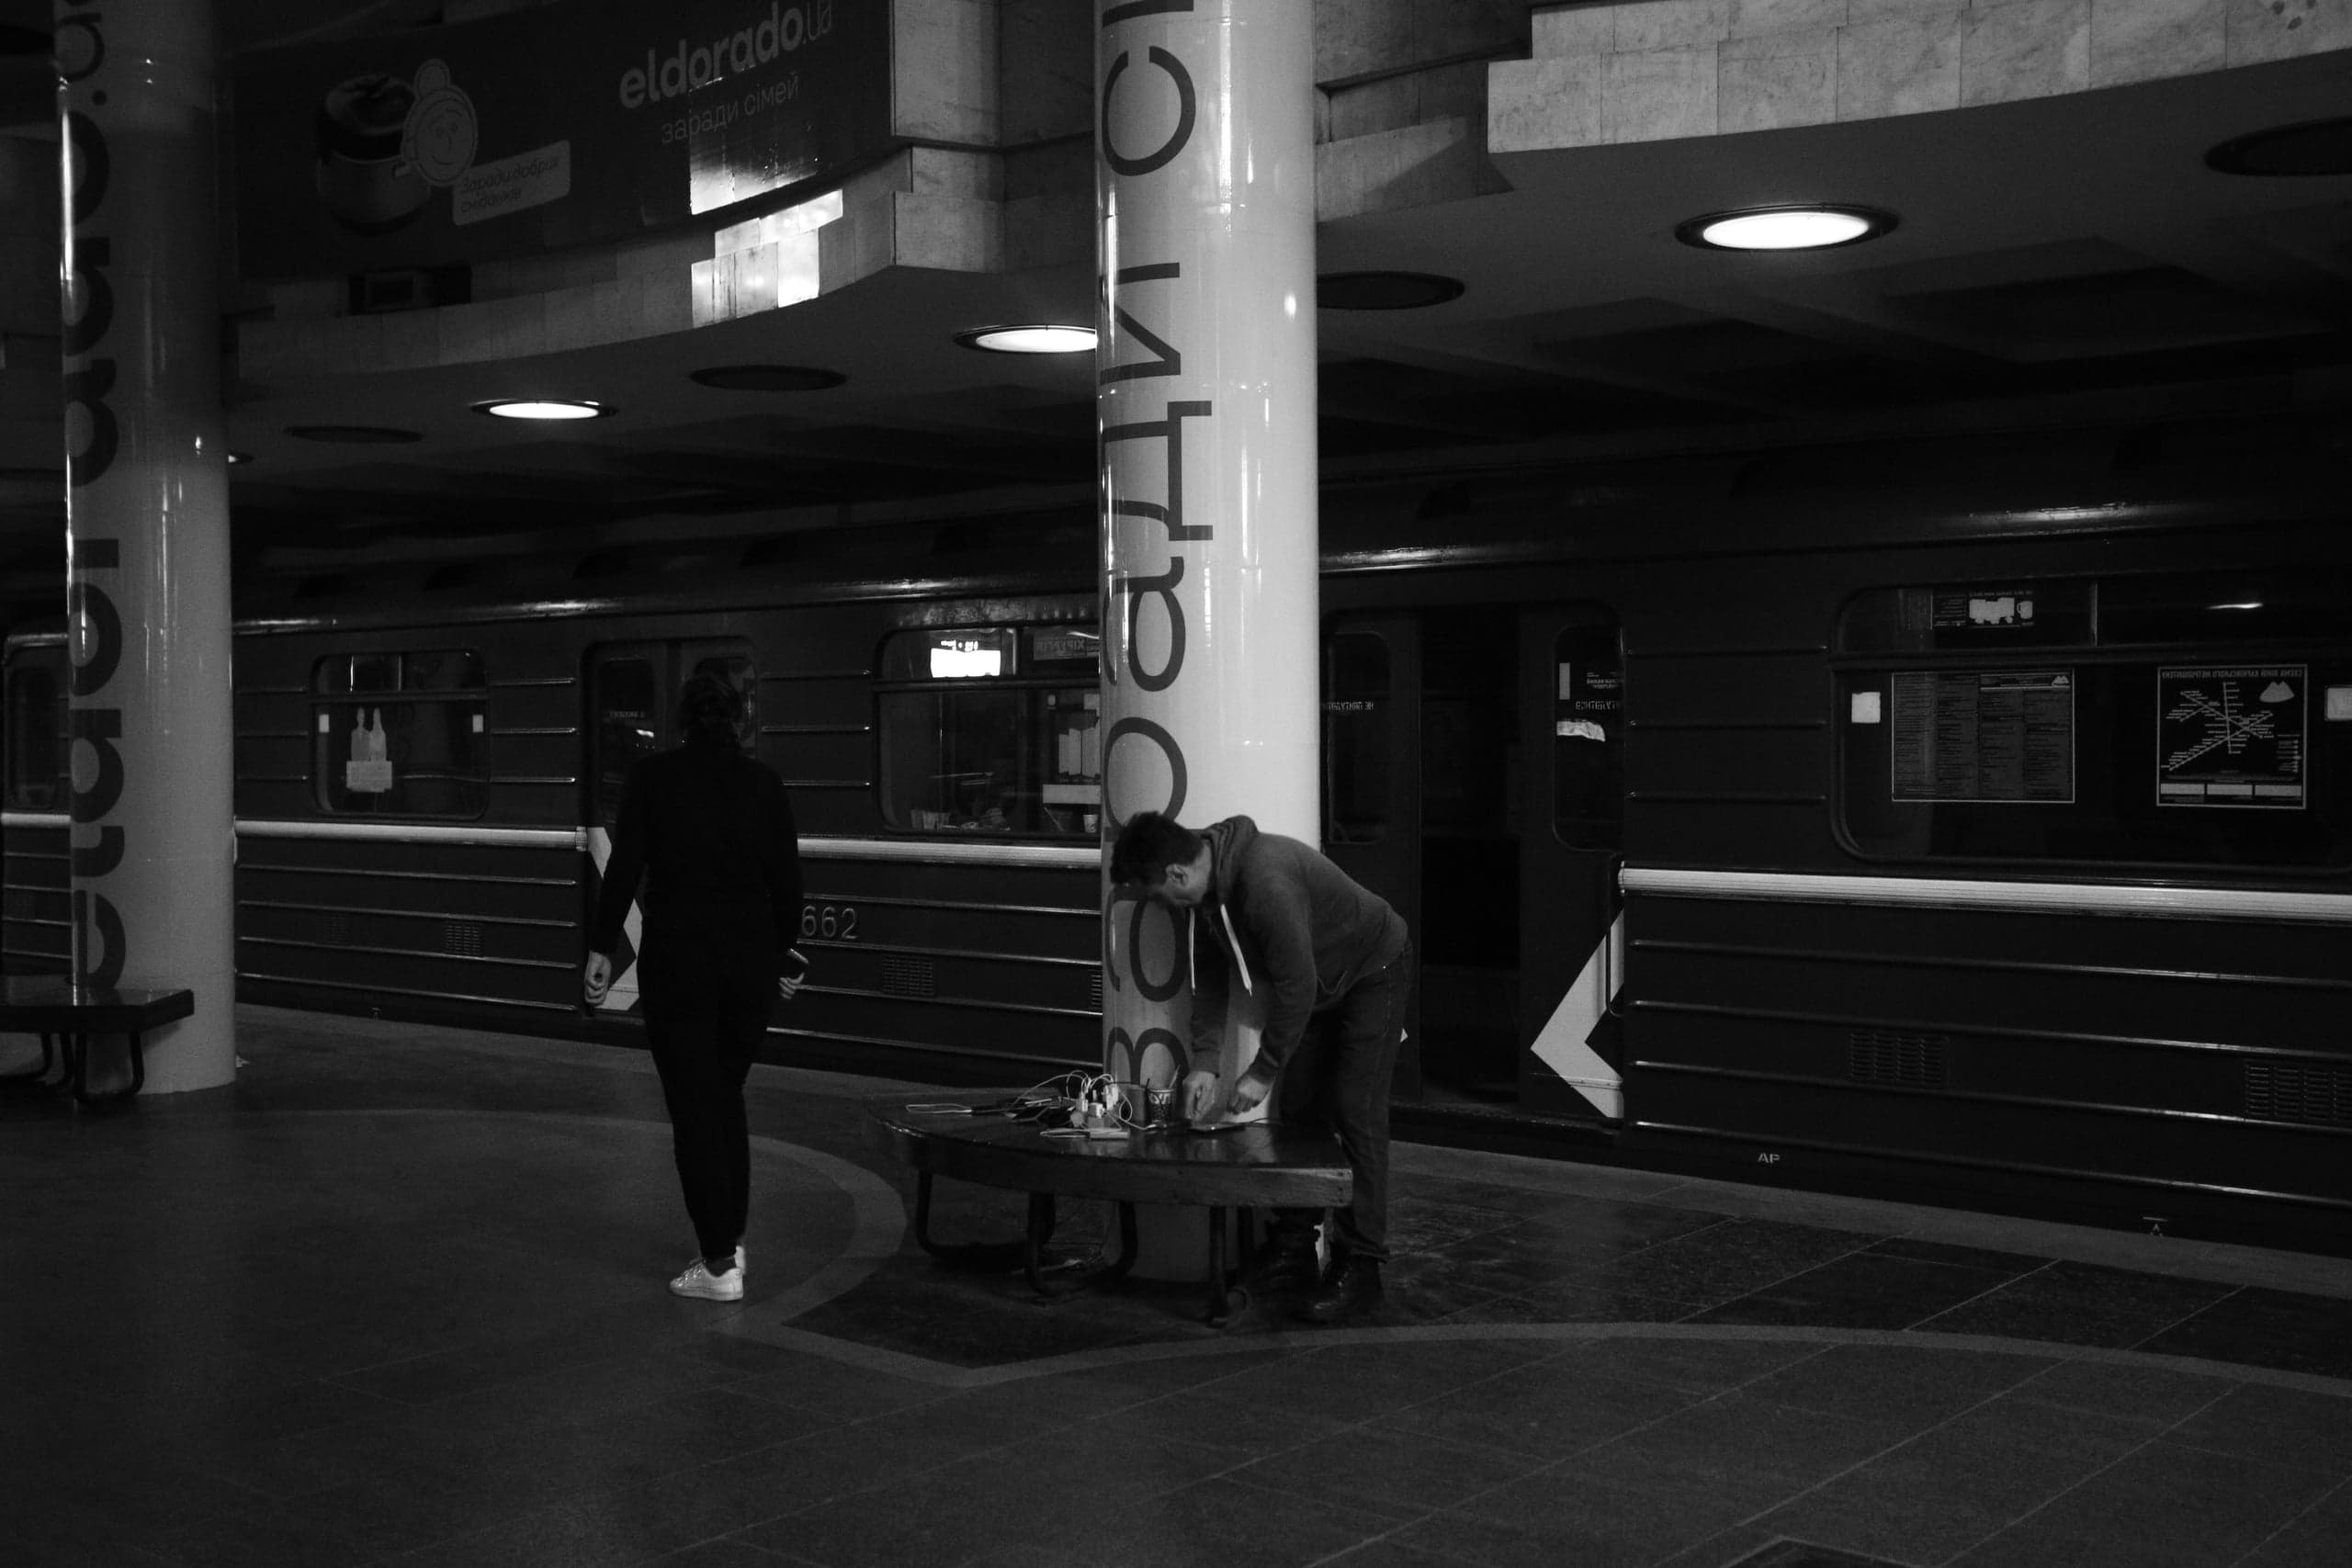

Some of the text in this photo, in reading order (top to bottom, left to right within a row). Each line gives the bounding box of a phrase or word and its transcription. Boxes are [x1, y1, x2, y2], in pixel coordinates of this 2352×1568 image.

[662, 69, 800, 144] заради сімей
[802, 906, 858, 939] 662
